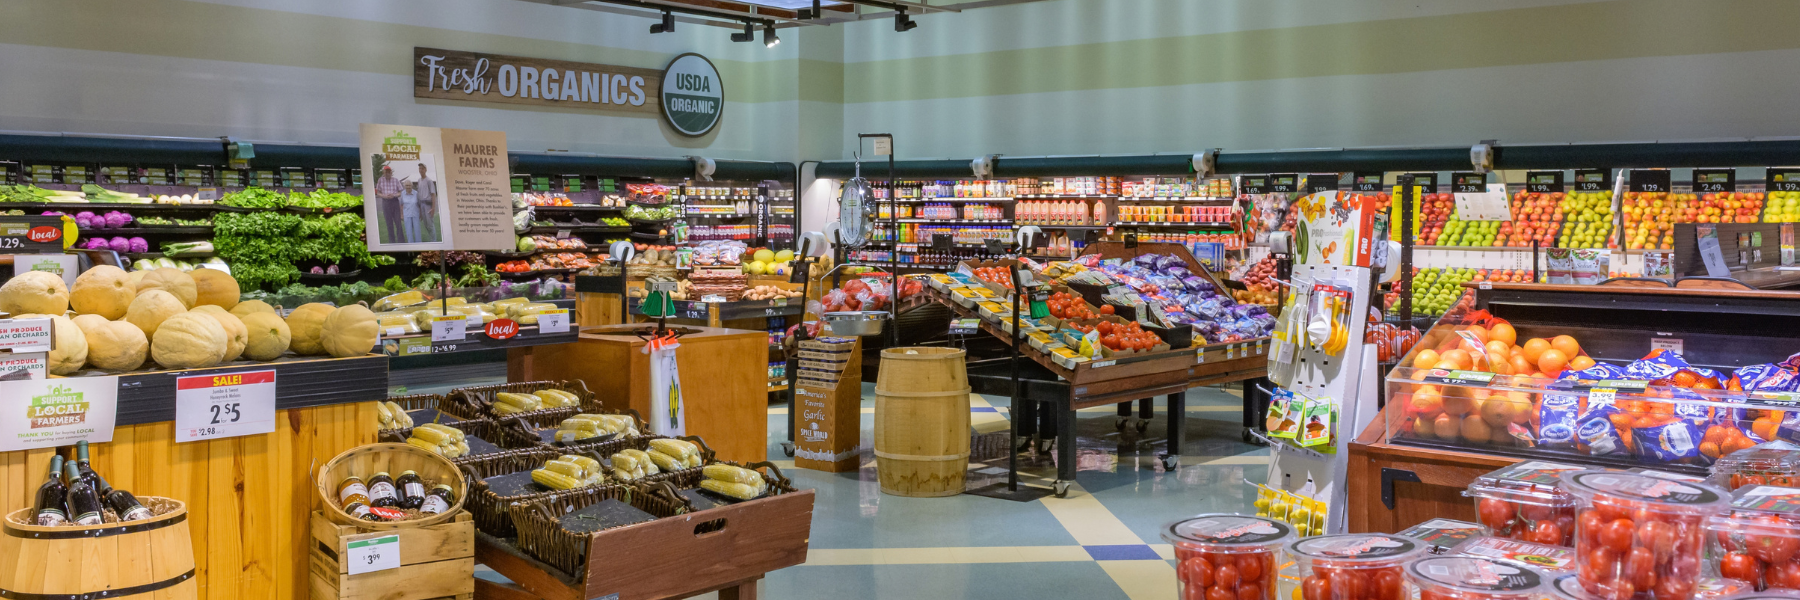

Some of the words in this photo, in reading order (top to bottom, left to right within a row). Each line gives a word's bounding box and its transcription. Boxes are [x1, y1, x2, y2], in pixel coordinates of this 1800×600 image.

[421, 54, 493, 94] Fresh
[498, 64, 646, 106] ORGANICS
[676, 72, 710, 93] USDA
[672, 97, 714, 114] ORGANIC
[453, 144, 498, 156] MAURER
[459, 157, 495, 169] FARMS
[32, 229, 57, 240] Local
[489, 322, 515, 335] Local
[213, 375, 242, 386] SALE!
[41, 395, 77, 404] SUPPORT
[804, 390, 826, 398] America's
[805, 399, 825, 408] Favorite
[35, 404, 84, 416] LOCAL
[210, 405, 220, 424] 2
[804, 410, 825, 421] Garlic
[37, 415, 80, 425] FARMERS
[801, 428, 812, 437] SPICE
[814, 429, 828, 439] WORLD
